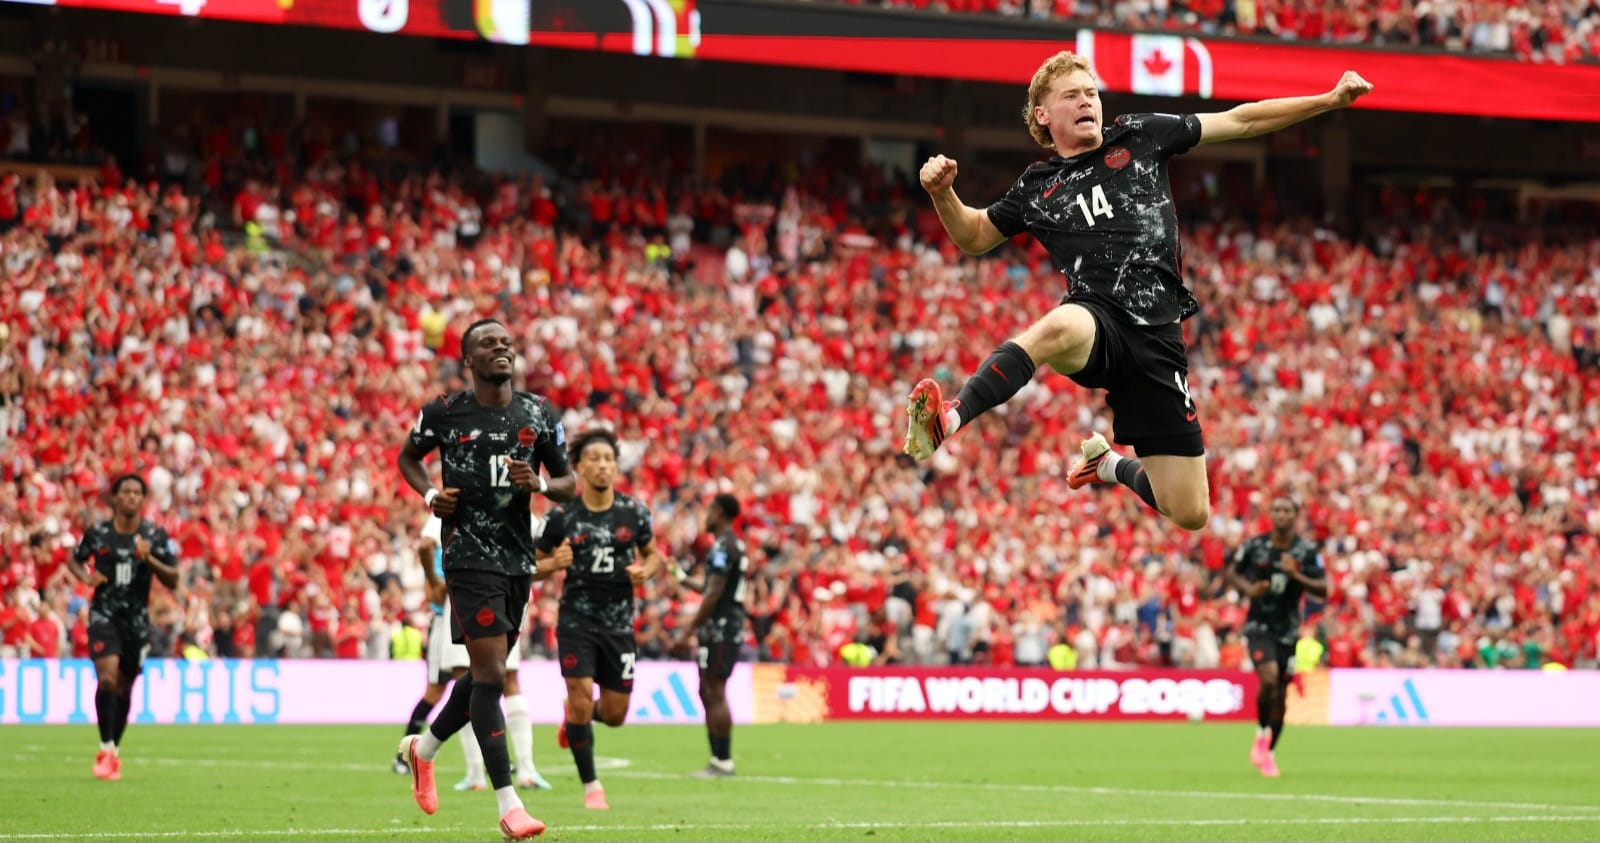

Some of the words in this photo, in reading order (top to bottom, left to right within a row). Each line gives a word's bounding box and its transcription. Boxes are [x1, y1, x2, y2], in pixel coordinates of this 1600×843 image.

[1076, 183, 1115, 227] 14
[489, 454, 512, 487] 12
[115, 562, 132, 586] 10
[591, 546, 615, 573] 25
[135, 658, 280, 724] THIS
[848, 675, 927, 713] FIFA
[924, 675, 1050, 714] WORLD
[1049, 676, 1120, 714] CUP
[1119, 677, 1235, 714] 2026
